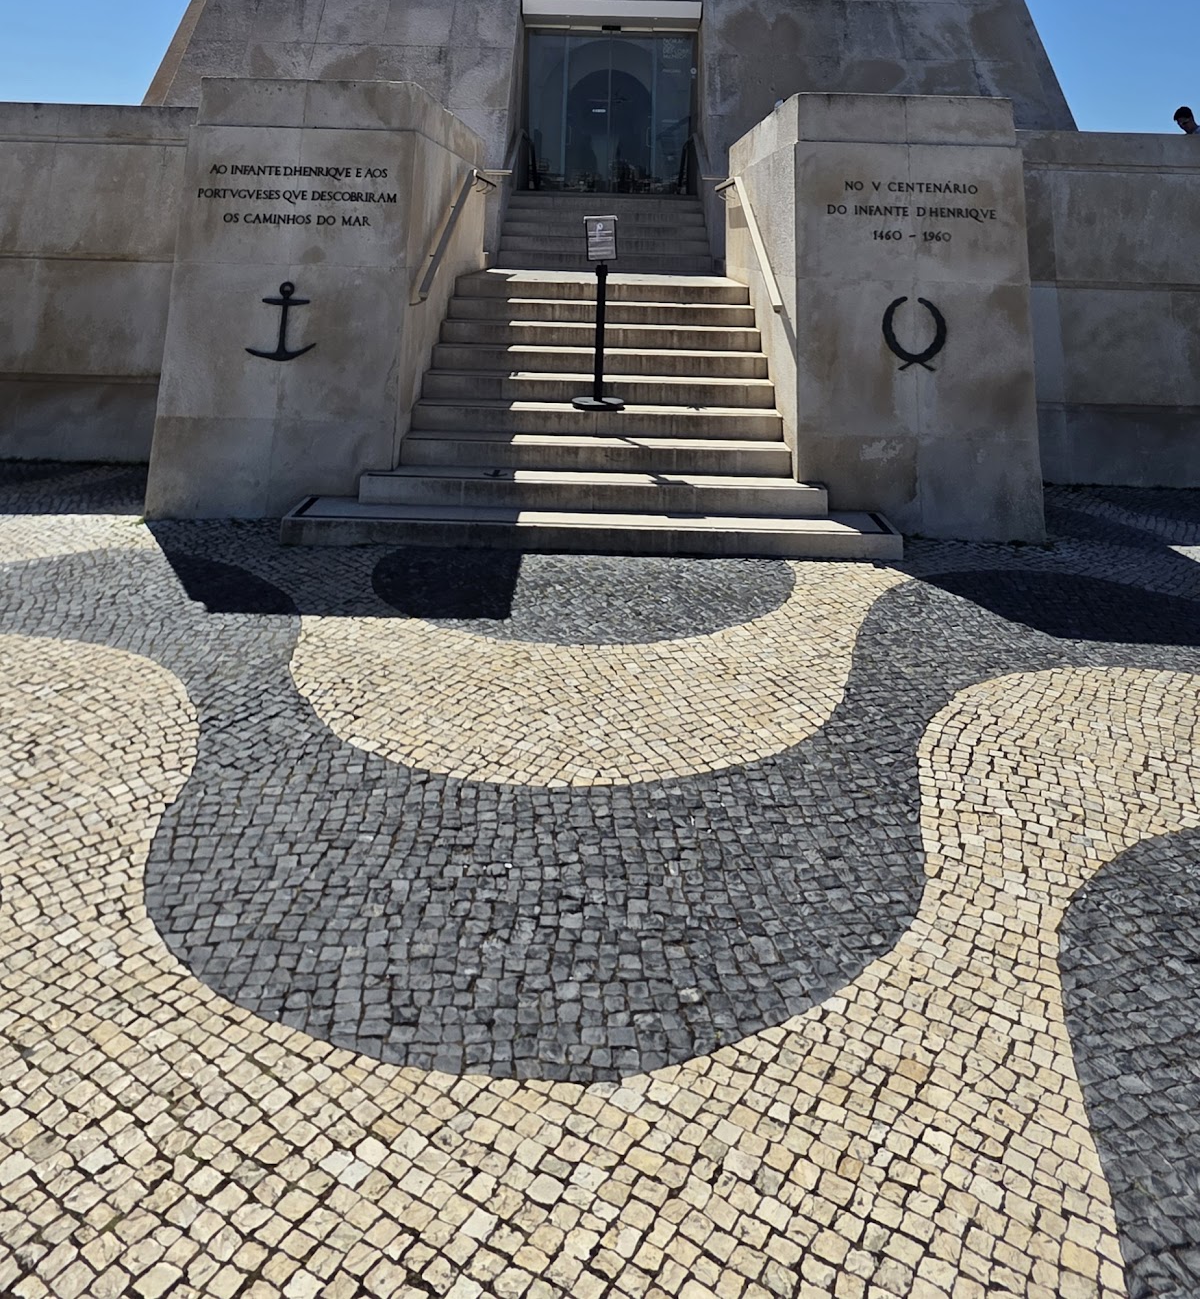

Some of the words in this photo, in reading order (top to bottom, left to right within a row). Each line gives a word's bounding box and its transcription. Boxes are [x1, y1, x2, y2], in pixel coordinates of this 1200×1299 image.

[209, 163, 228, 175] AO
[230, 164, 282, 176] INFANTE
[355, 167, 363, 178] E
[364, 168, 388, 179] AOS
[844, 180, 864, 191] NO
[872, 181, 881, 191] V
[887, 180, 978, 195] CENTENÁRIO
[197, 187, 281, 200] PORTVGVESES
[282, 189, 308, 204] QVE
[310, 190, 398, 203] DESCOBRIRAM
[827, 204, 847, 215] DO
[854, 205, 909, 217] INFANTE
[223, 212, 240, 224] OS
[243, 213, 312, 225] CAMINHOS
[316, 215, 336, 226] DO
[341, 215, 371, 227] MAR
[873, 230, 902, 241] 1460
[923, 231, 952, 242] 1960
